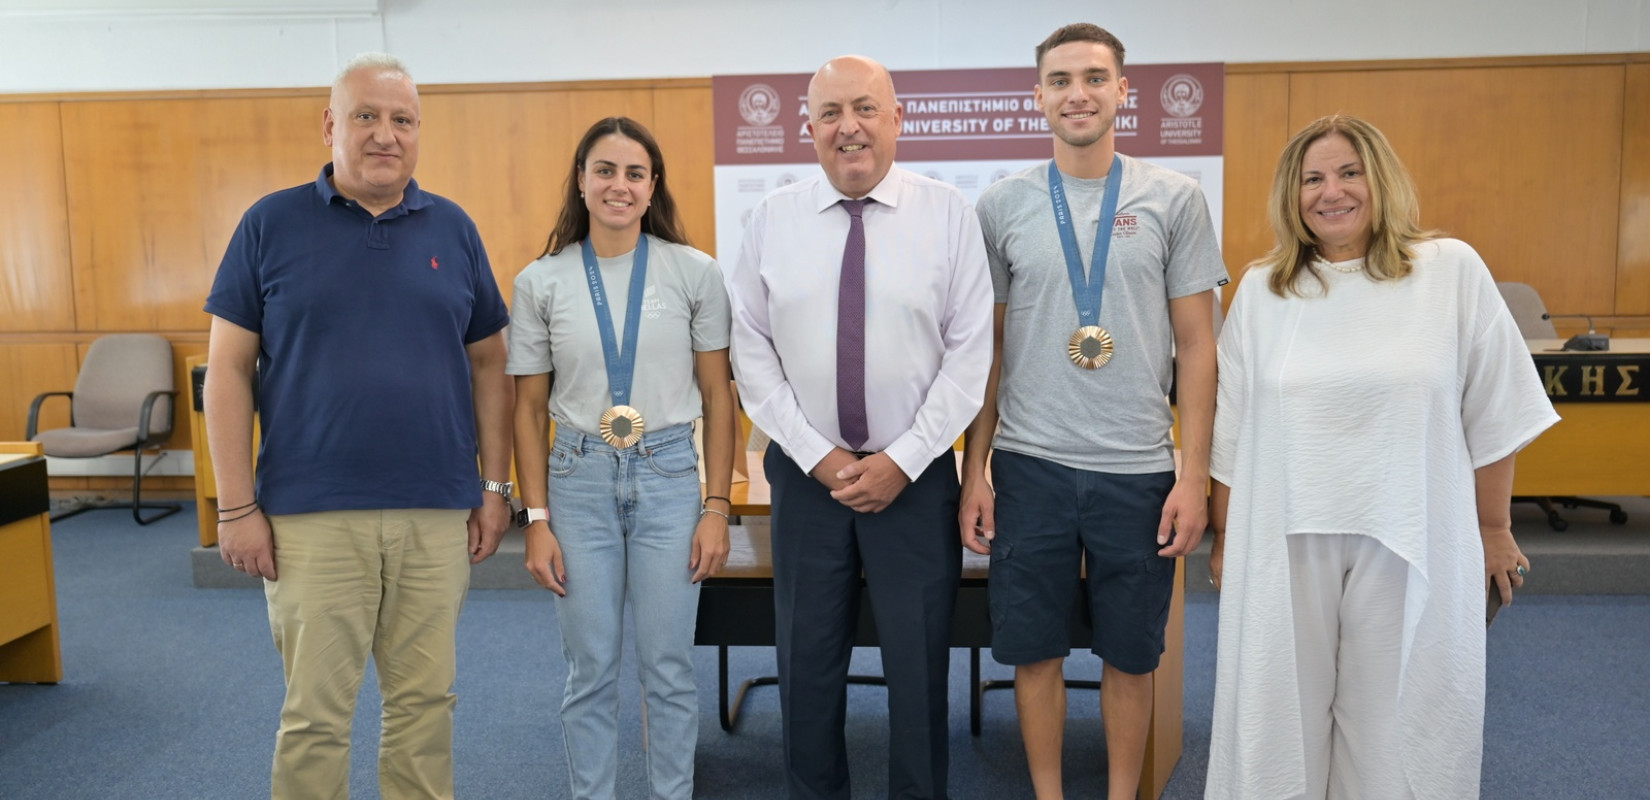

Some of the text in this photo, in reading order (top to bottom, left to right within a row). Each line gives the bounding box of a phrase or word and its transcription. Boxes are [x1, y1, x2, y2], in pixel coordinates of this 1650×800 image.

[906, 98, 1019, 114] ΠΑΝΕΠΙΣΤΗΜΙΟ
[903, 118, 989, 134] NIVERSITY
[992, 118, 1014, 132] OF
